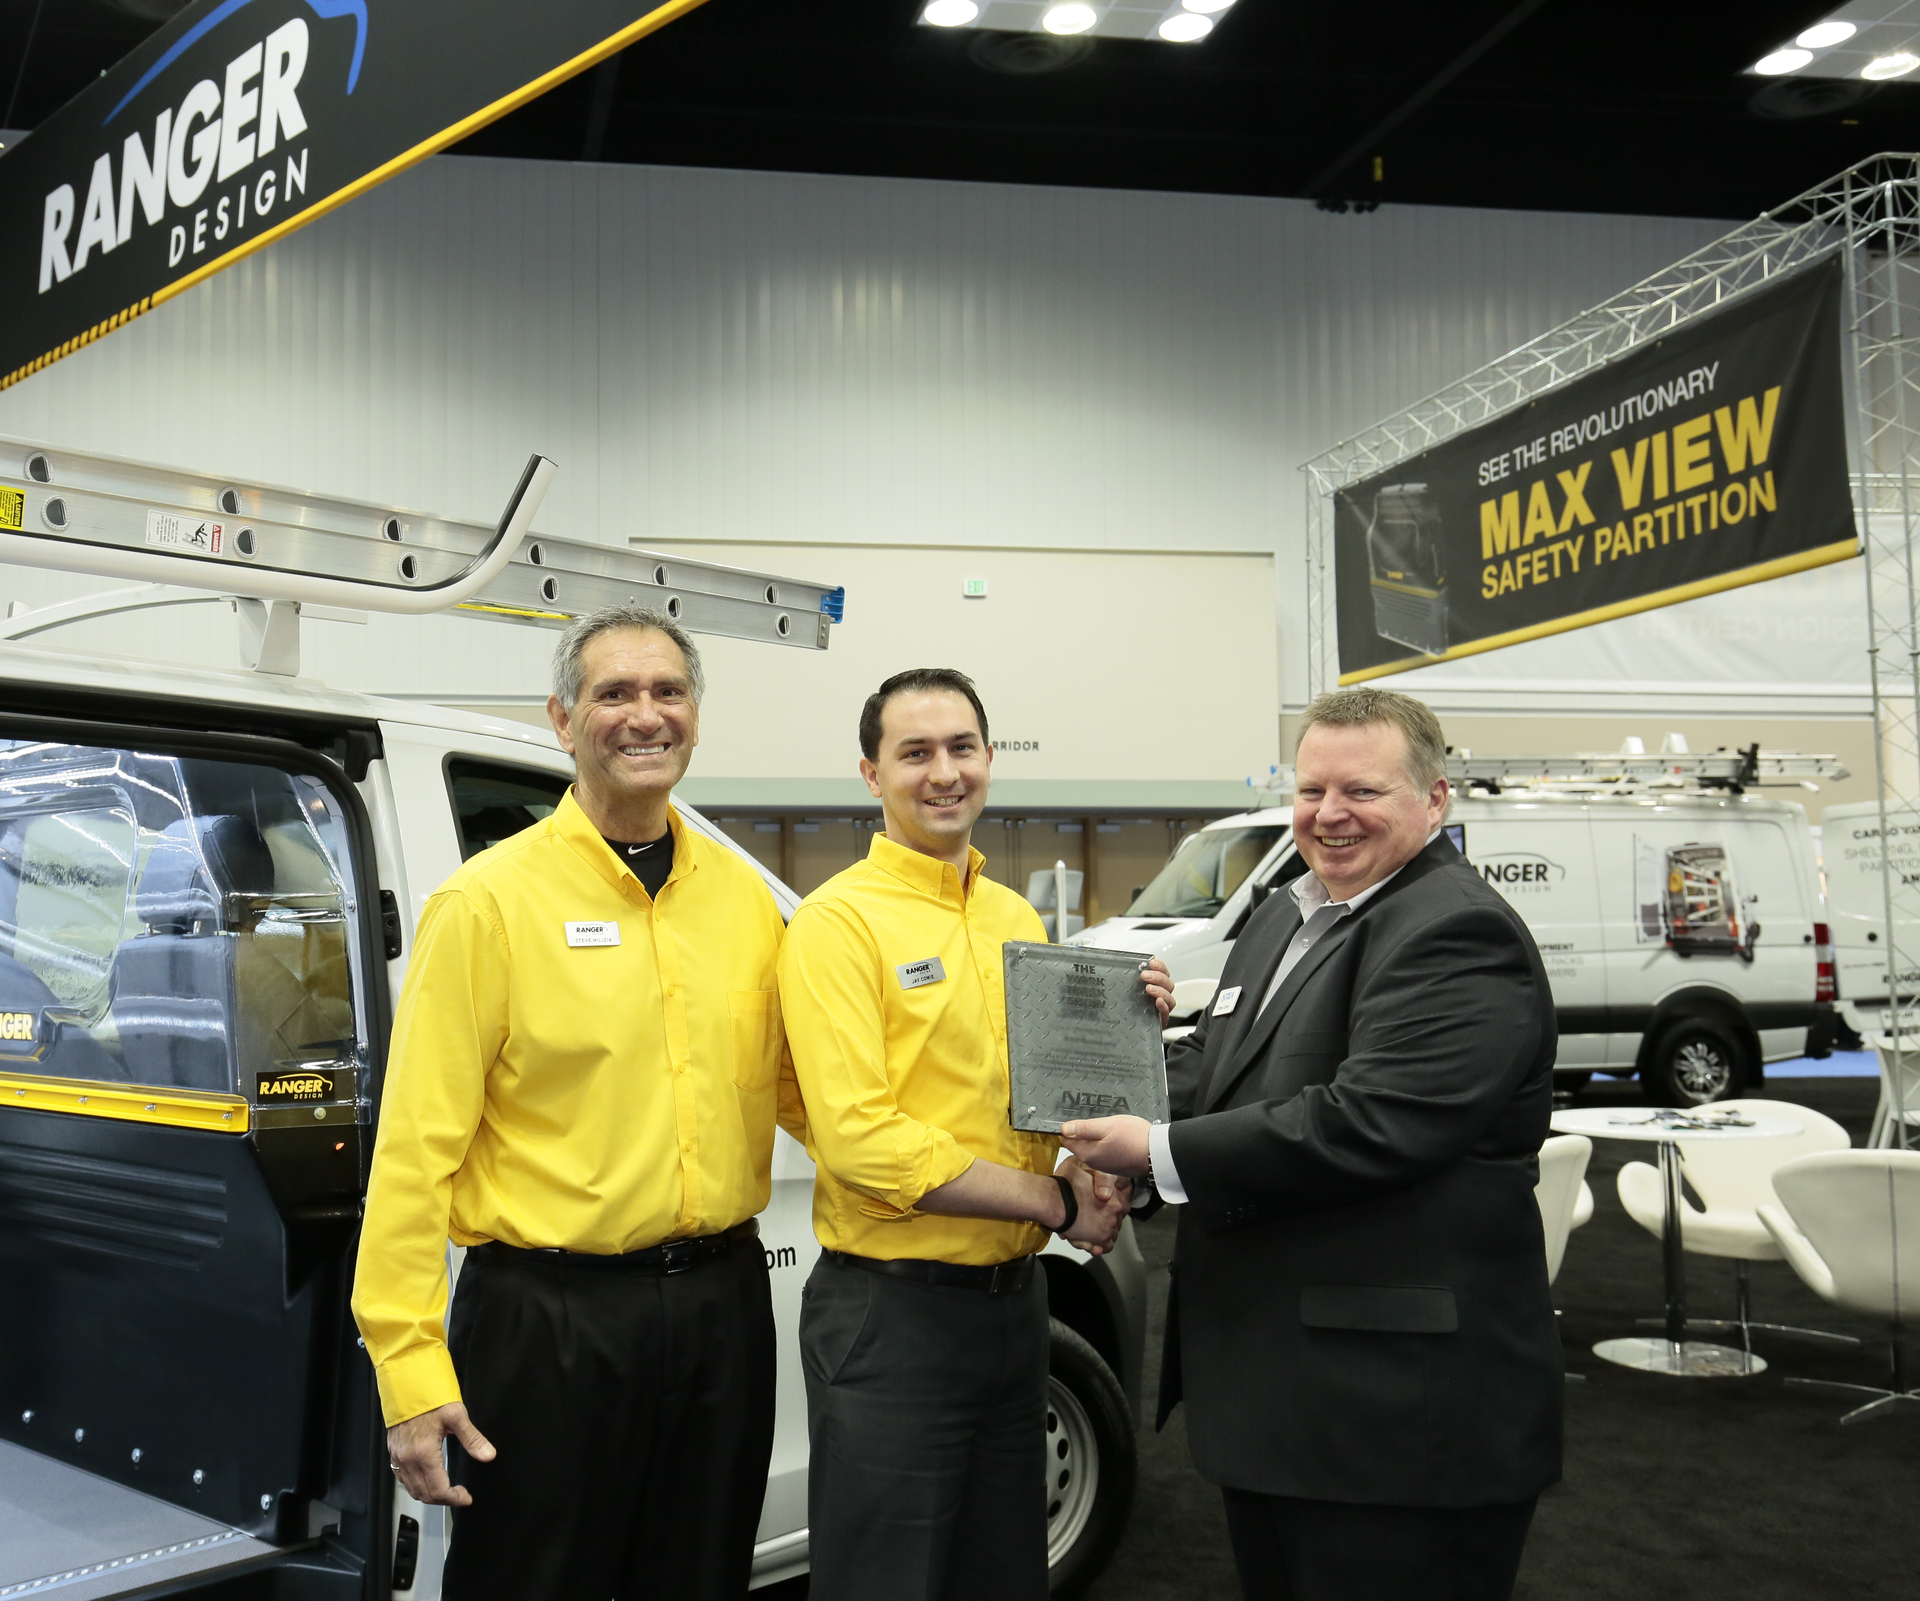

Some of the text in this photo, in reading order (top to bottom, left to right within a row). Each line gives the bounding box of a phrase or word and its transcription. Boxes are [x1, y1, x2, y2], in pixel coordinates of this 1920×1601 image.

[38, 17, 310, 295] RANGER
[168, 147, 309, 269] DESIGN
[1478, 361, 1719, 487] SEE THE REVOLUTIONARY
[1480, 385, 1782, 559] MAX VIEW
[1481, 470, 1778, 599] SAFETY PARTITION
[967, 580, 985, 594] EXIT
[1852, 828, 1899, 840] CARO
[1505, 885, 1551, 893] DESIGN
[906, 964, 930, 975] RANGER
[1073, 963, 1096, 974] THE
[0, 1012, 33, 1040] GER
[259, 1079, 323, 1095] RANGER
[293, 1092, 323, 1100] DESIGN
[1061, 1090, 1131, 1111] NTEA
